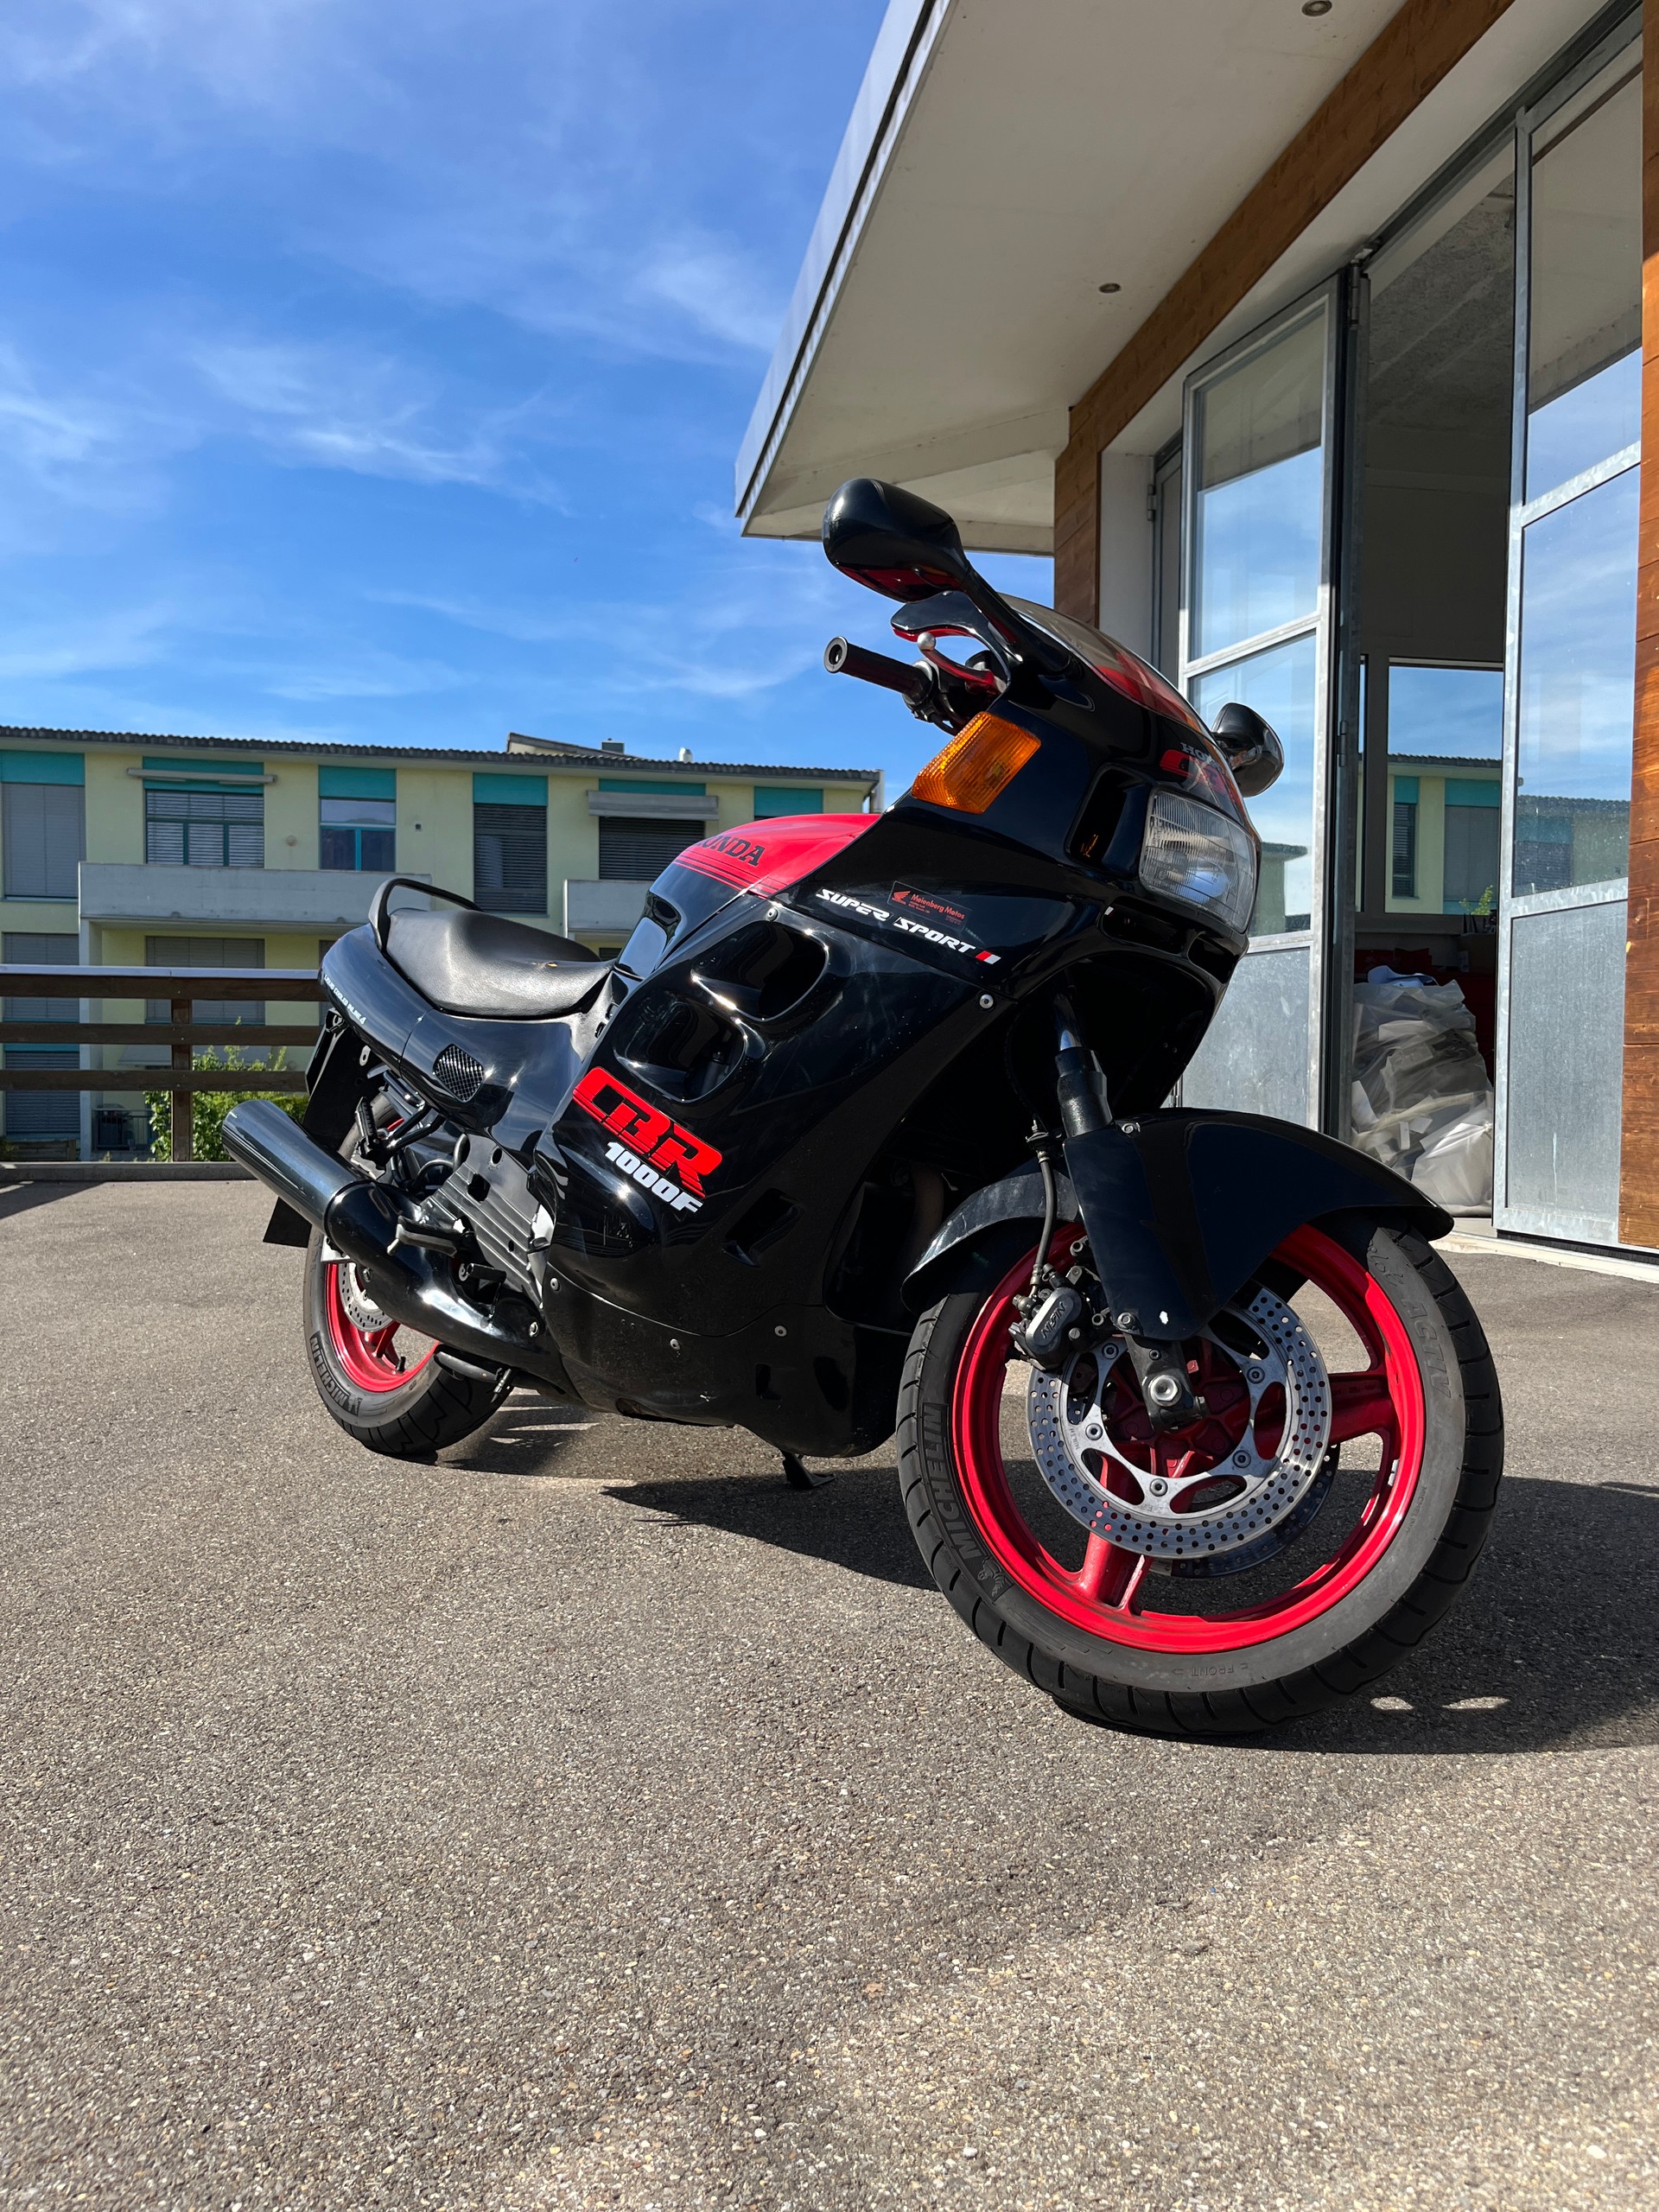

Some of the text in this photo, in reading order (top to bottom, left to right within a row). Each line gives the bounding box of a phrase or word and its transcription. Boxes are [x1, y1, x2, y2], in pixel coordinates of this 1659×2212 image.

[696, 836, 765, 867] ONDA
[816, 888, 976, 953] SUPER SPORT
[911, 893, 944, 913] Meienberg
[334, 987, 349, 1007] COOLED
[359, 1016, 367, 1025] 4
[572, 1066, 722, 1198] CBR
[605, 1141, 703, 1212] 1000F
[310, 1337, 348, 1408] MICHELIN
[924, 1404, 983, 1560] MICHELIN
[1192, 1664, 1235, 1676] FRONT
